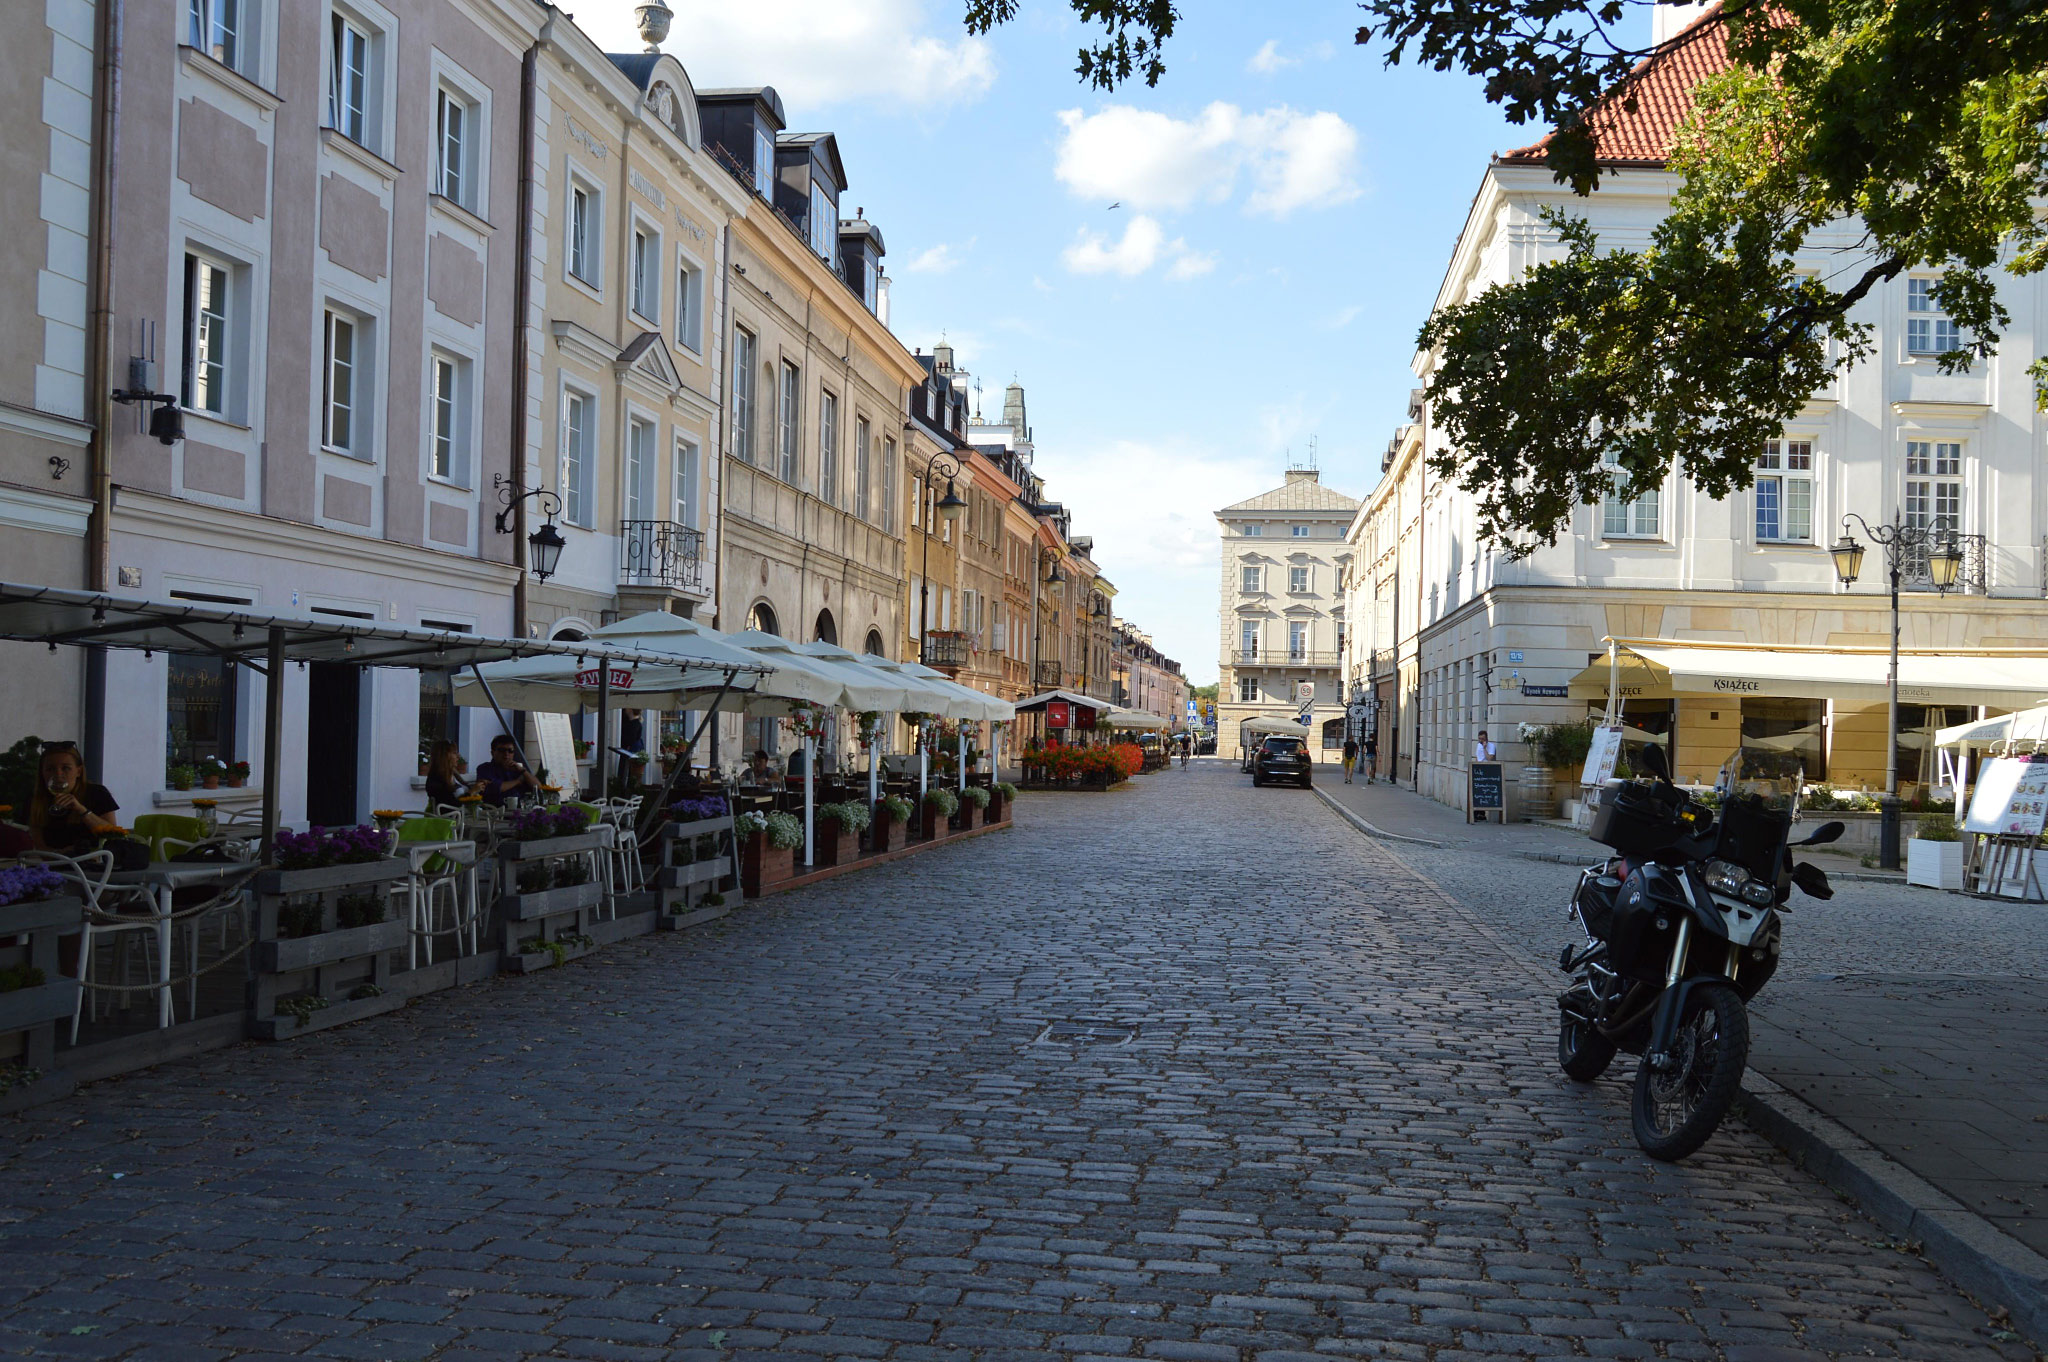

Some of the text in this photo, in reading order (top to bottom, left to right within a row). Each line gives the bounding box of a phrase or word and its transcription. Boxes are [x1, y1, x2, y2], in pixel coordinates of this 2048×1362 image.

[580, 672, 627, 686] ŻYIEC
[1714, 679, 1759, 692] KSIĄŻĘCE
[1603, 686, 1642, 697] KIĄŻĘCE
